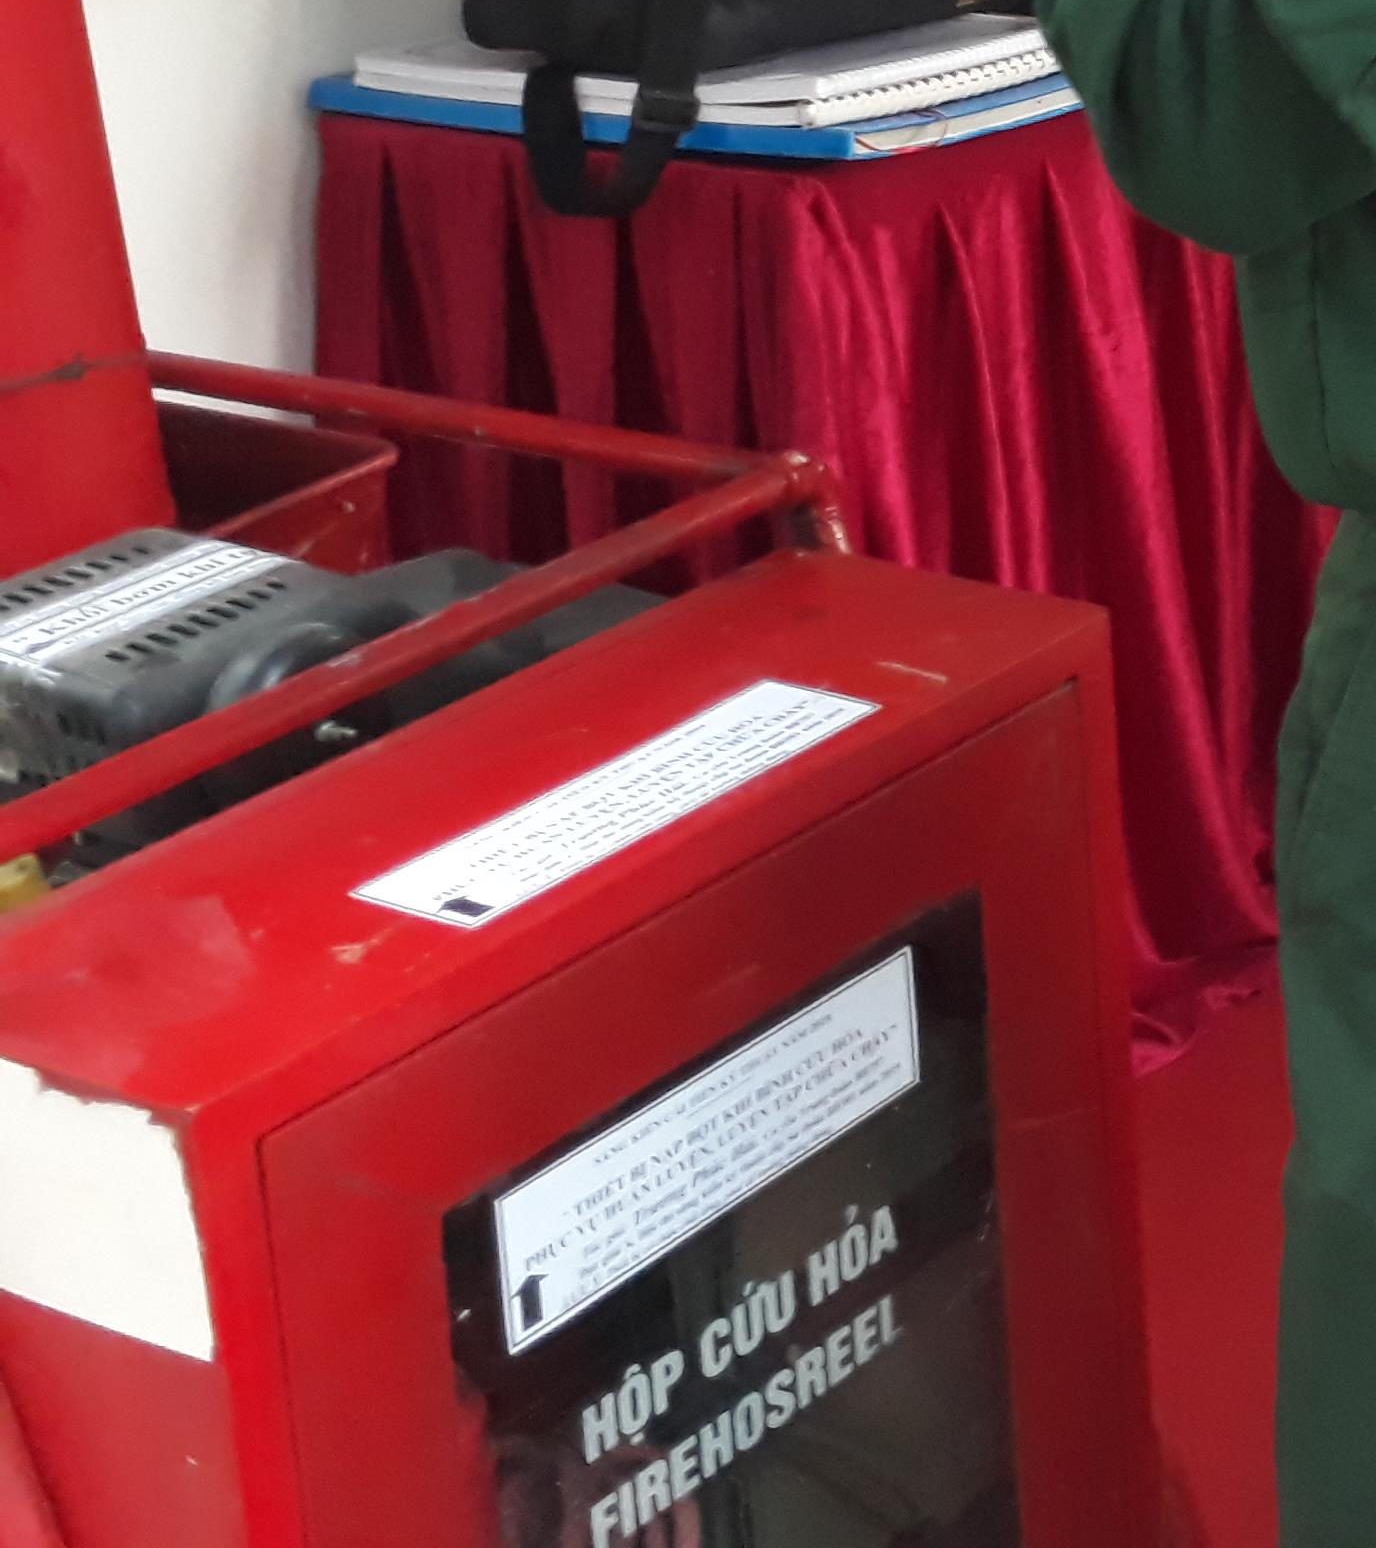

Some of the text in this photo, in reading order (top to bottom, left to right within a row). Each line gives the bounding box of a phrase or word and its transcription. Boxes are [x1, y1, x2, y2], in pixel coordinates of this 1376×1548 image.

[582, 1204, 899, 1465] HỘP CỨU HỎA
